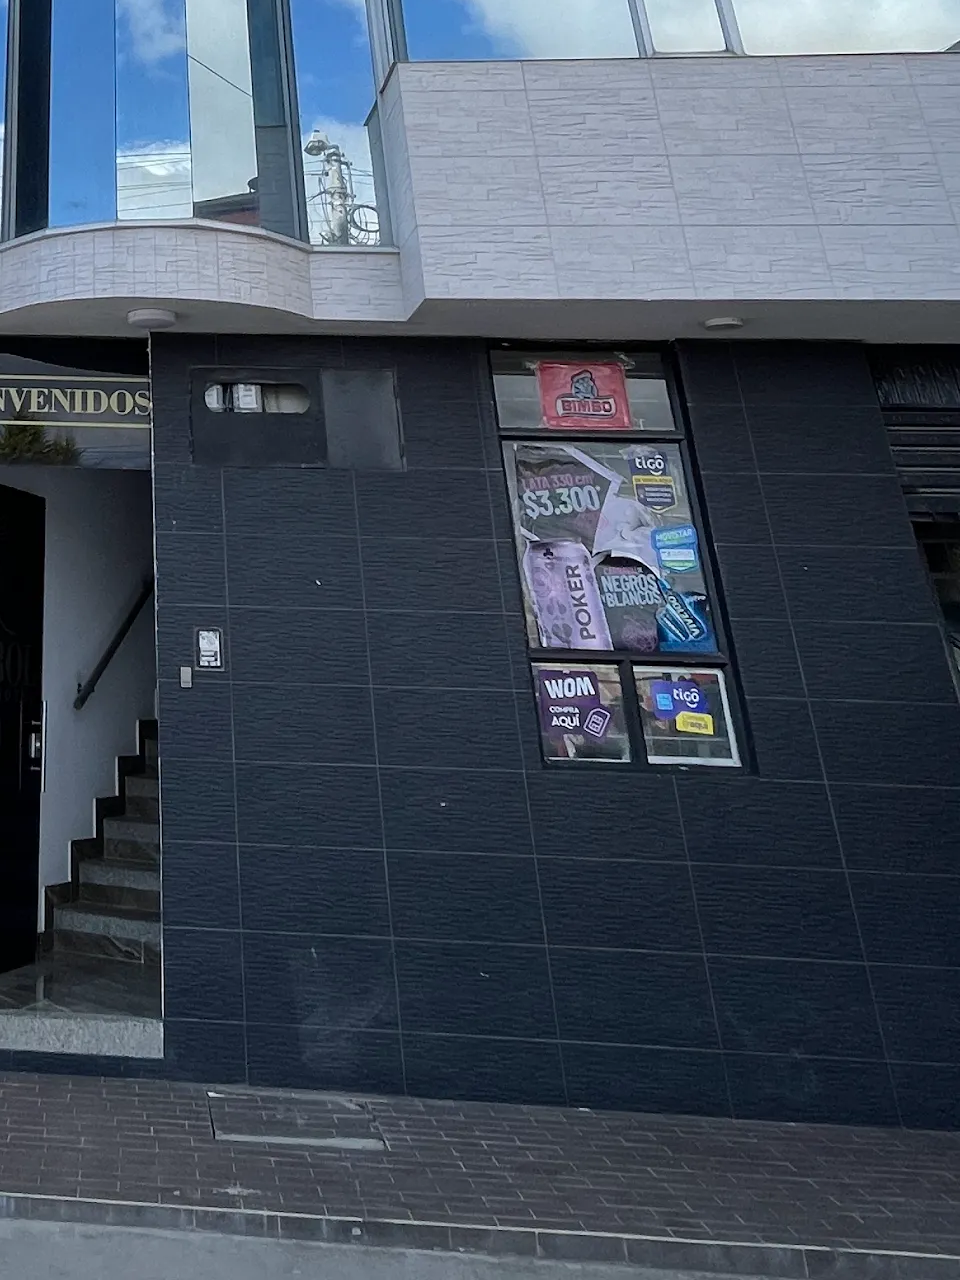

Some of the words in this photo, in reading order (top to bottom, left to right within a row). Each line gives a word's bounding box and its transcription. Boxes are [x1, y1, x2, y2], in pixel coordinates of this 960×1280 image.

[561, 399, 612, 413] BIMBO
[550, 473, 574, 487] 330
[600, 572, 658, 593] NEGROS
[565, 564, 597, 641] POKER
[605, 590, 662, 608] BLANCOS
[543, 676, 596, 699] WOM
[548, 705, 580, 714] COMPRA
[551, 714, 580, 730] AQUÍ
